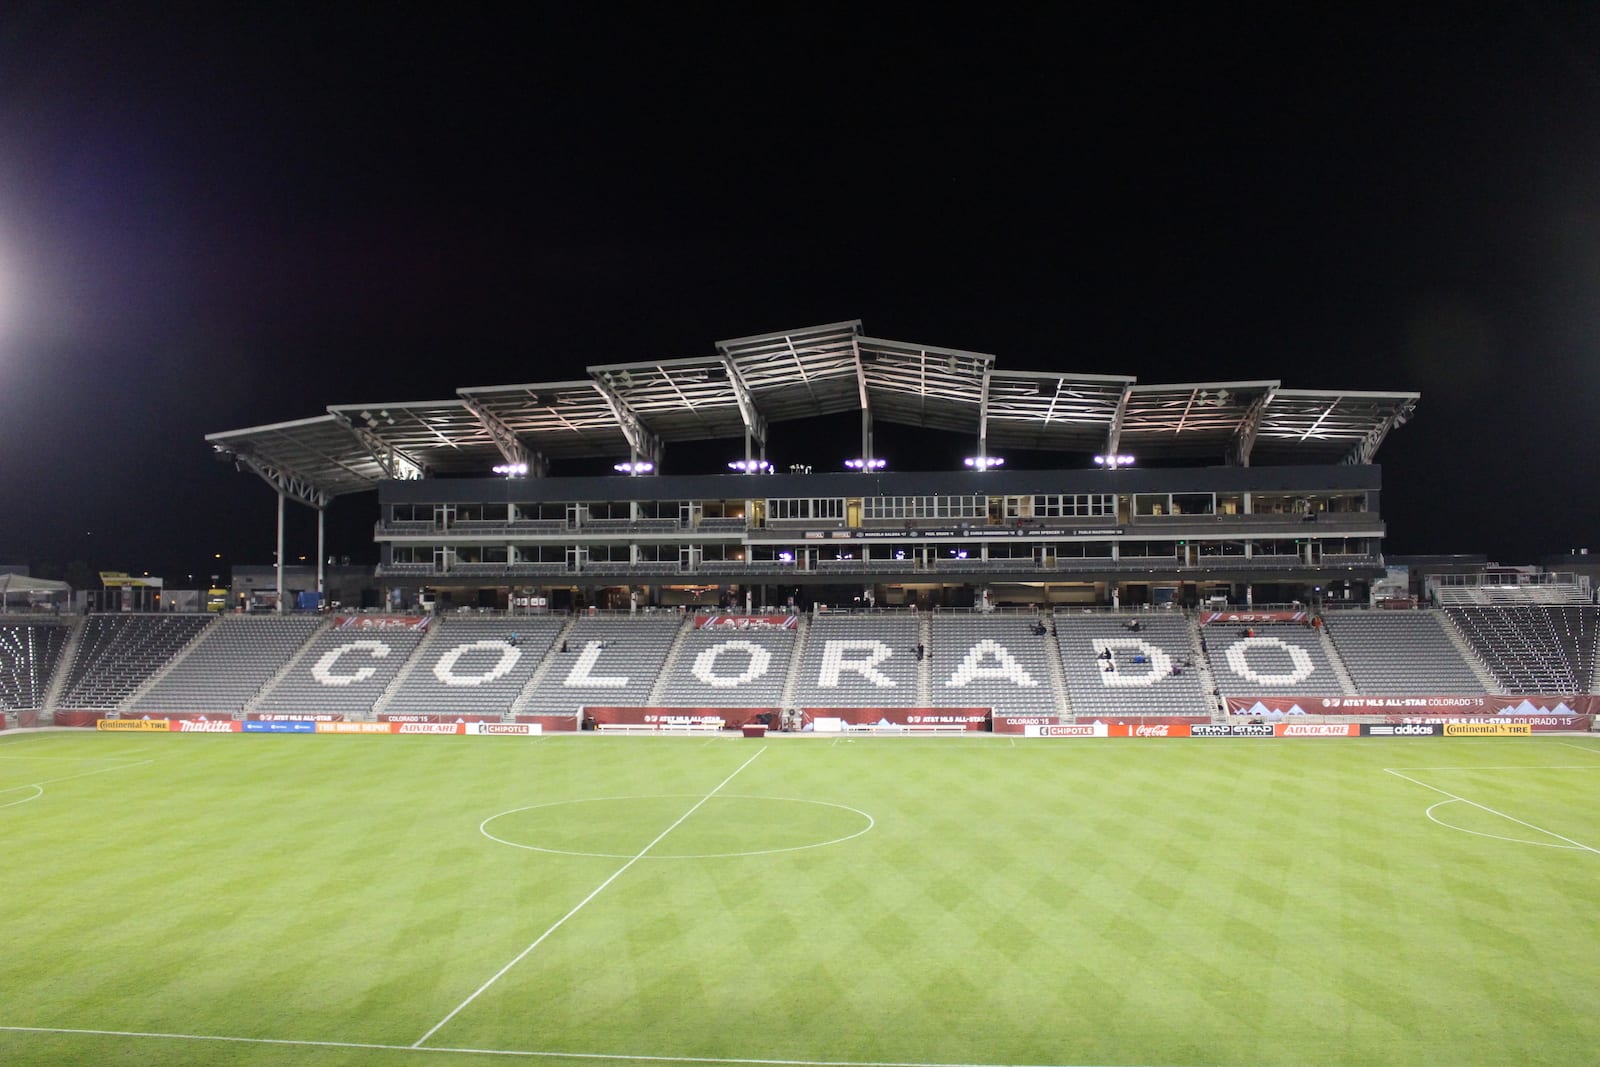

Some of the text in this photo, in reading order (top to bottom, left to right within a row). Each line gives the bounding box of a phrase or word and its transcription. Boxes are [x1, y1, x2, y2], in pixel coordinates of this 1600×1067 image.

[311, 637, 1315, 688] COLORADO
[99, 720, 142, 731] Continental
[179, 719, 233, 732] Makita
[400, 724, 458, 734] ADVOCARE
[489, 726, 528, 734] CHIPOTLE
[1284, 725, 1348, 735] ADVOCARE
[1394, 725, 1433, 735] adidas
[1446, 724, 1498, 735] Continental
[1051, 727, 1093, 735] CHIPOTLE
